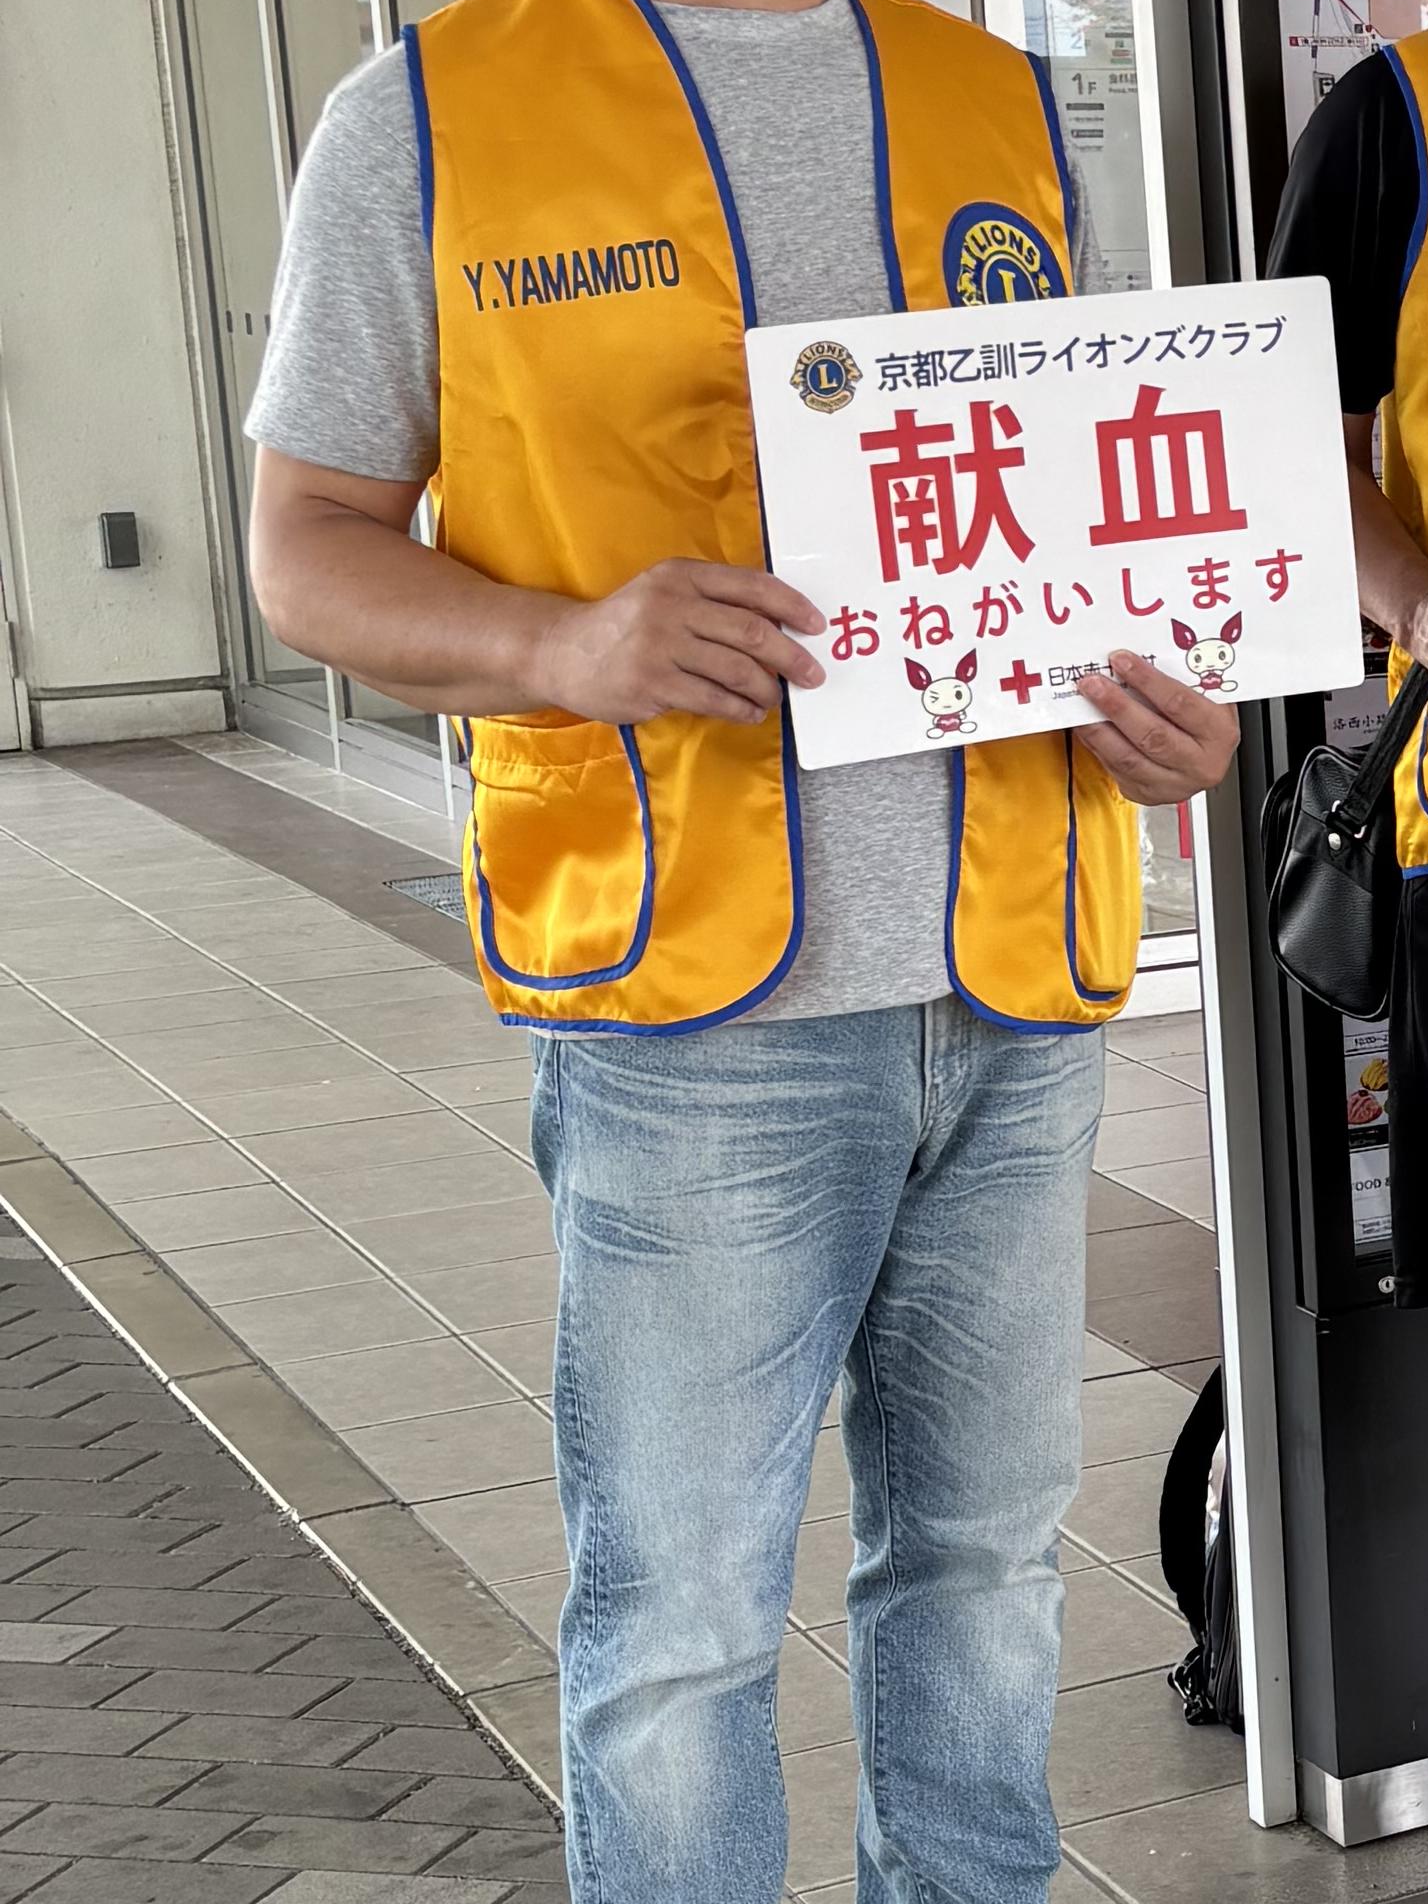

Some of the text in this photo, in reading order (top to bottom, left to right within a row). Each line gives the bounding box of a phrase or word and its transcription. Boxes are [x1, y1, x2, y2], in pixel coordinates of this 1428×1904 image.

[462, 238, 680, 312] Y.YAMAMOTO
[970, 224, 1036, 265] LIONS
[875, 316, 1287, 394] 京都乙訓ライオンズクラブ
[859, 384, 1248, 584] 献血
[830, 548, 1304, 662] おねがいします
